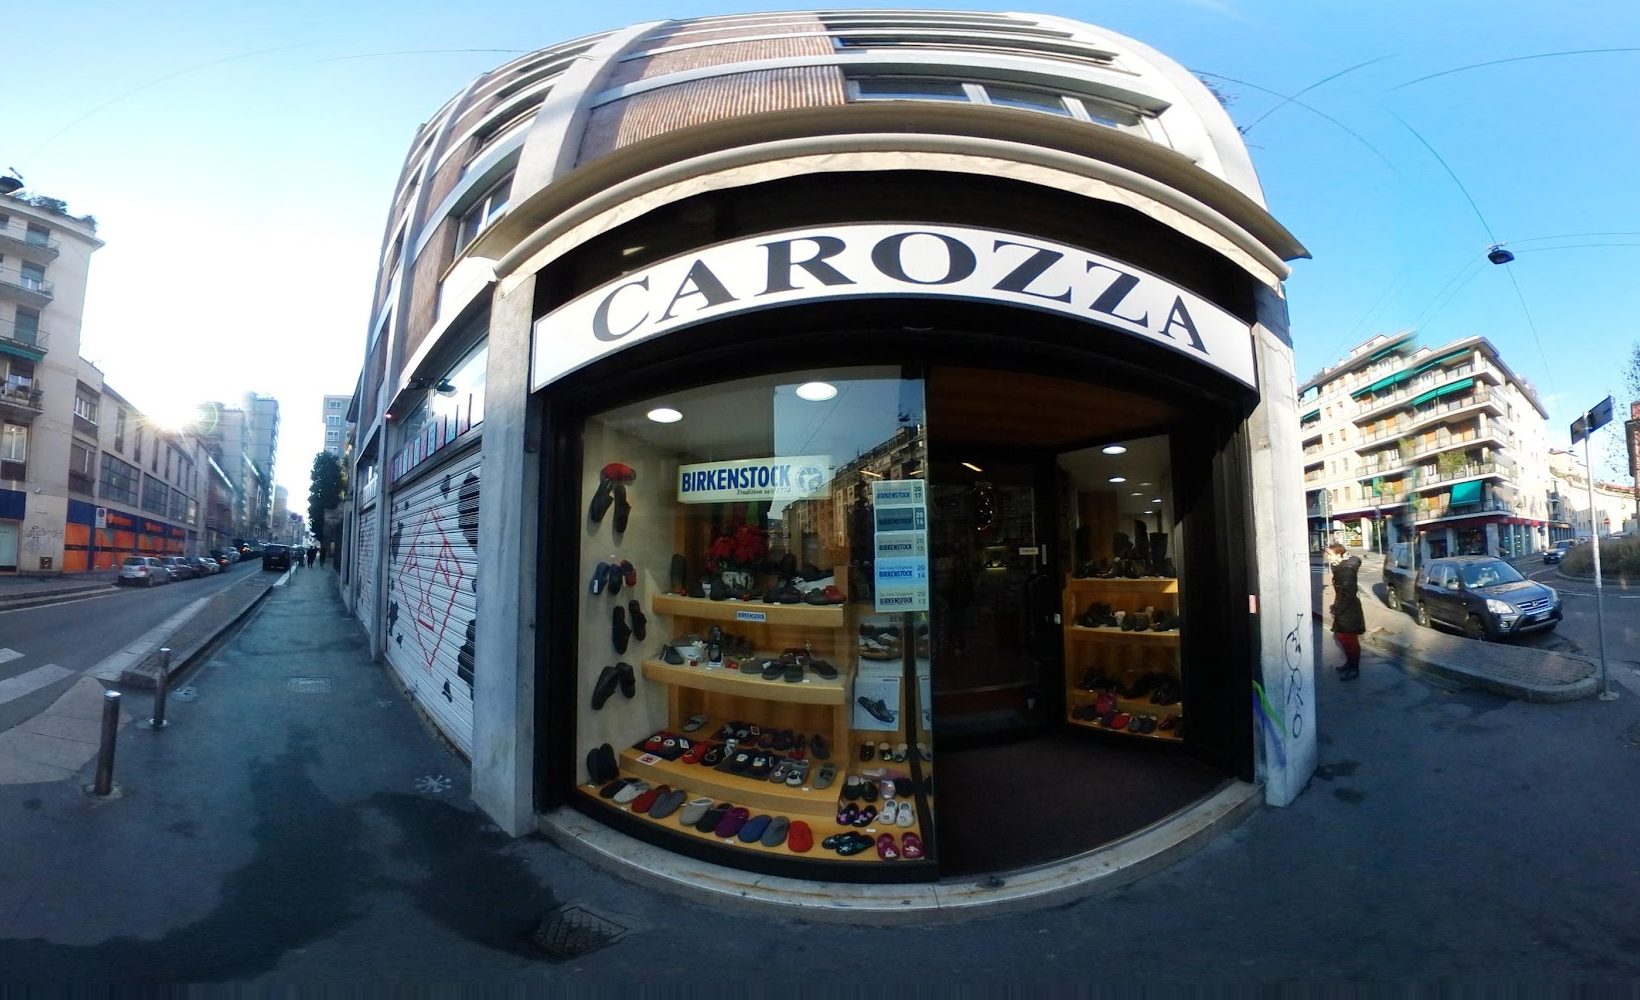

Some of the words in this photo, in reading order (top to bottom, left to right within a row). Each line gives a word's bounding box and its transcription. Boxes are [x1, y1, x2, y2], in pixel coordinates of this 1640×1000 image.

[592, 231, 1211, 356] CAROZZA
[682, 465, 791, 492] BIRKENSTOCK
[879, 570, 912, 578] BIRKENSTOCK
[880, 597, 912, 605] BIRKENSTOCK
